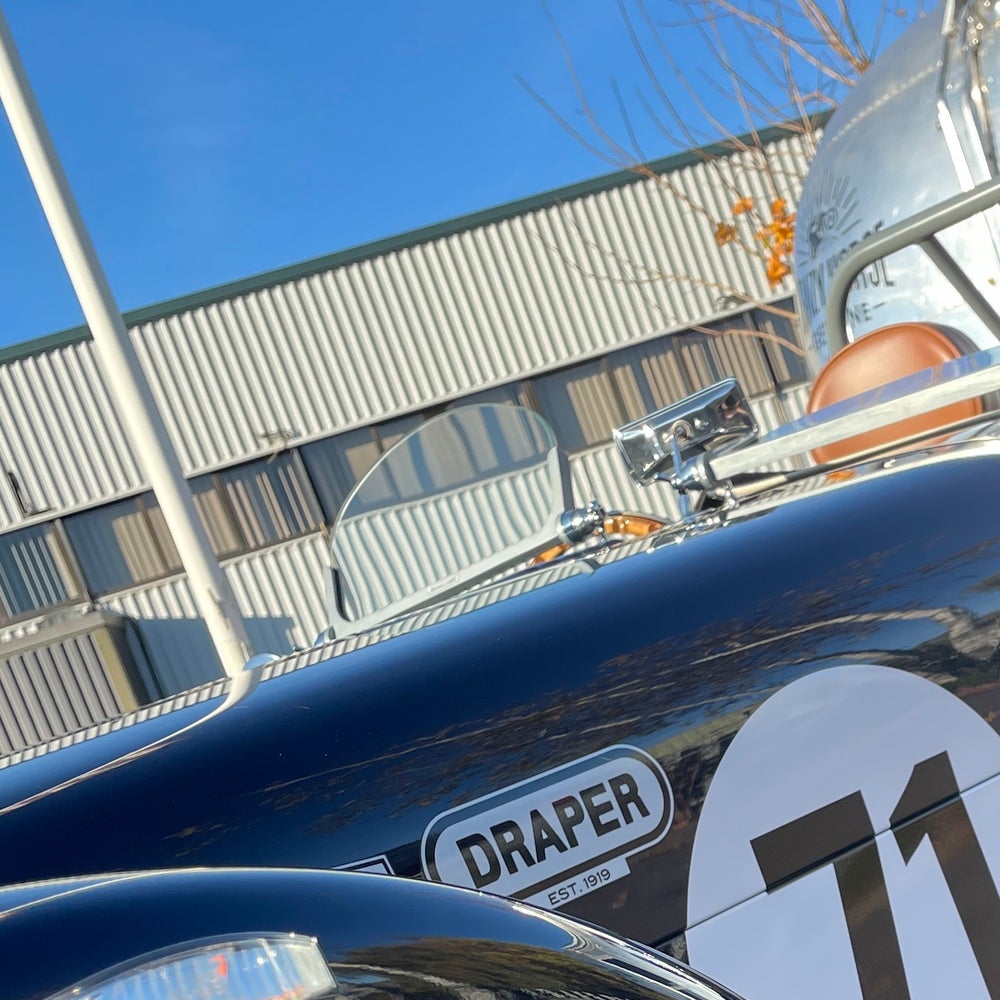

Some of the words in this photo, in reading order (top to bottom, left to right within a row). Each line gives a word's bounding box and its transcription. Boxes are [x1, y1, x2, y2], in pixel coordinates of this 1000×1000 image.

[456, 773, 651, 889] DRAPER
[548, 881, 583, 906] EST.
[583, 868, 612, 891] 1919
